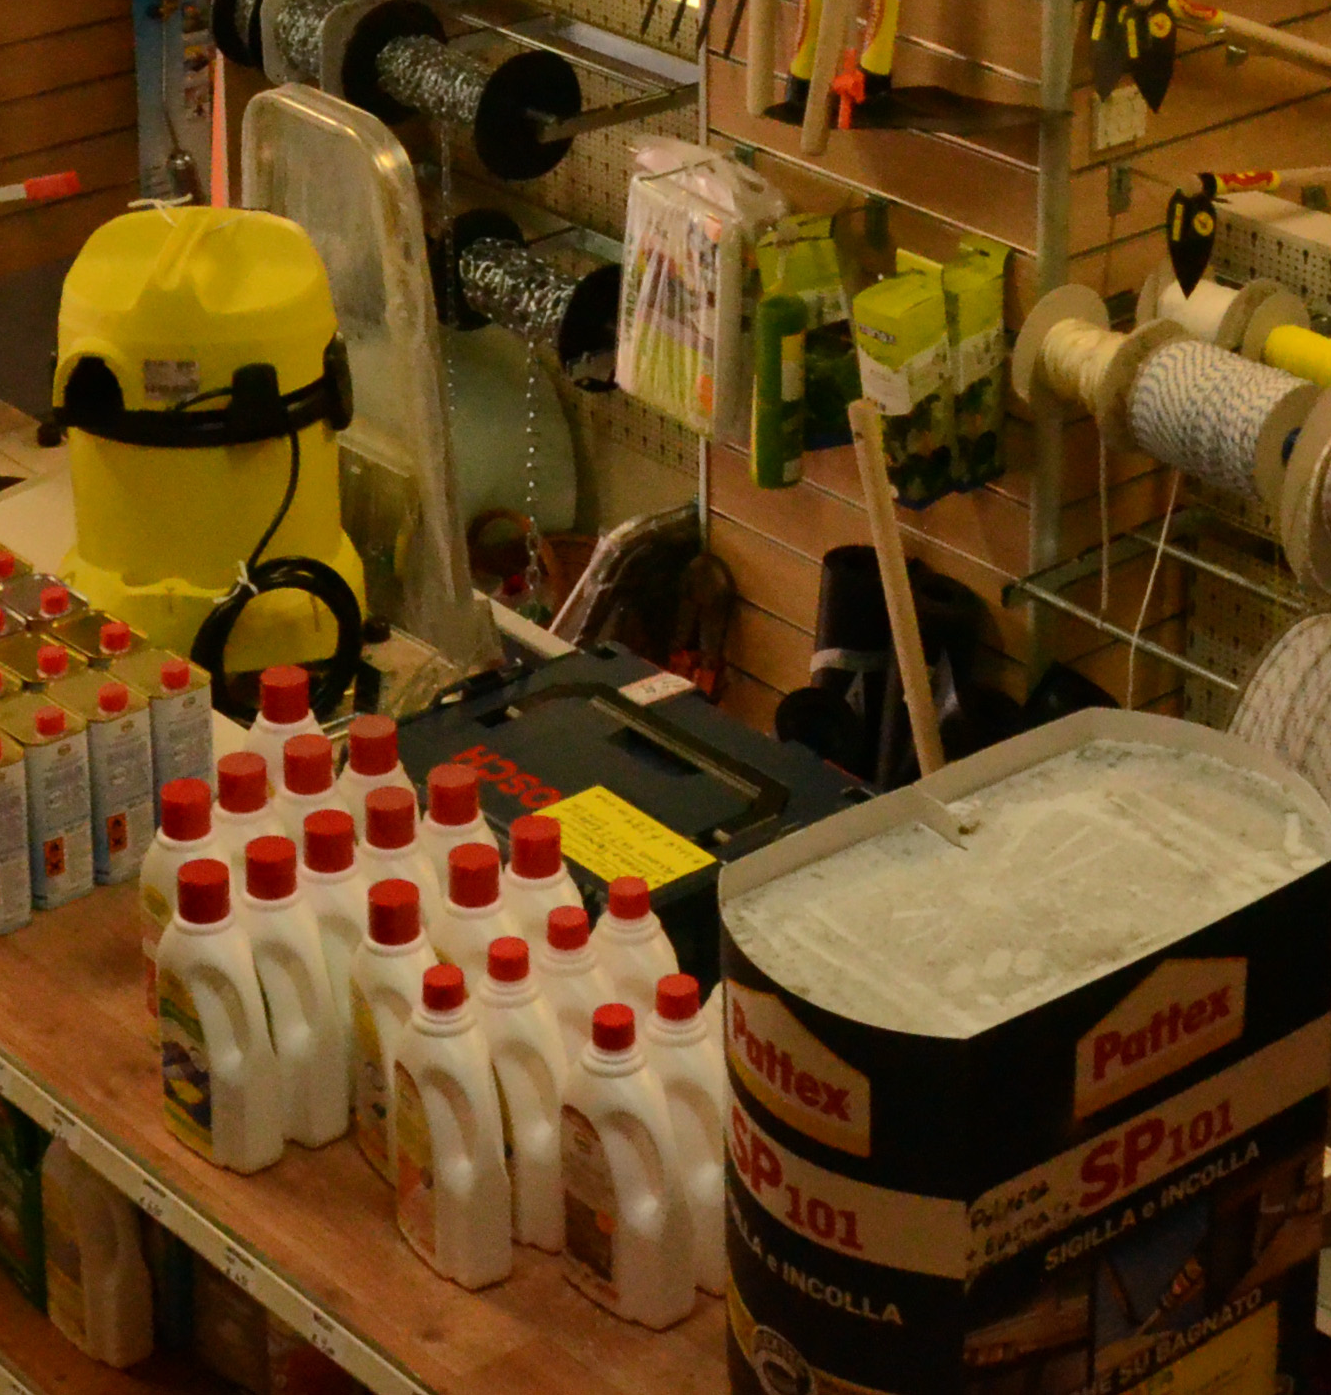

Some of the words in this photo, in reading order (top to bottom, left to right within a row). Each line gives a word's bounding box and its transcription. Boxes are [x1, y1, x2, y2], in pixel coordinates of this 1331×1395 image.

[453, 744, 562, 809] OSCH
[732, 996, 853, 1122] Pattex
[1092, 985, 1231, 1082] Pattex
[731, 1104, 864, 1252] SP101
[1077, 1098, 1235, 1208] SP101
[1044, 1207, 1138, 1271] SIGILLA
[1159, 1140, 1261, 1207] INCOLLA
[781, 1260, 904, 1326] INCOLLA
[1154, 1287, 1264, 1364] BAGNATO
